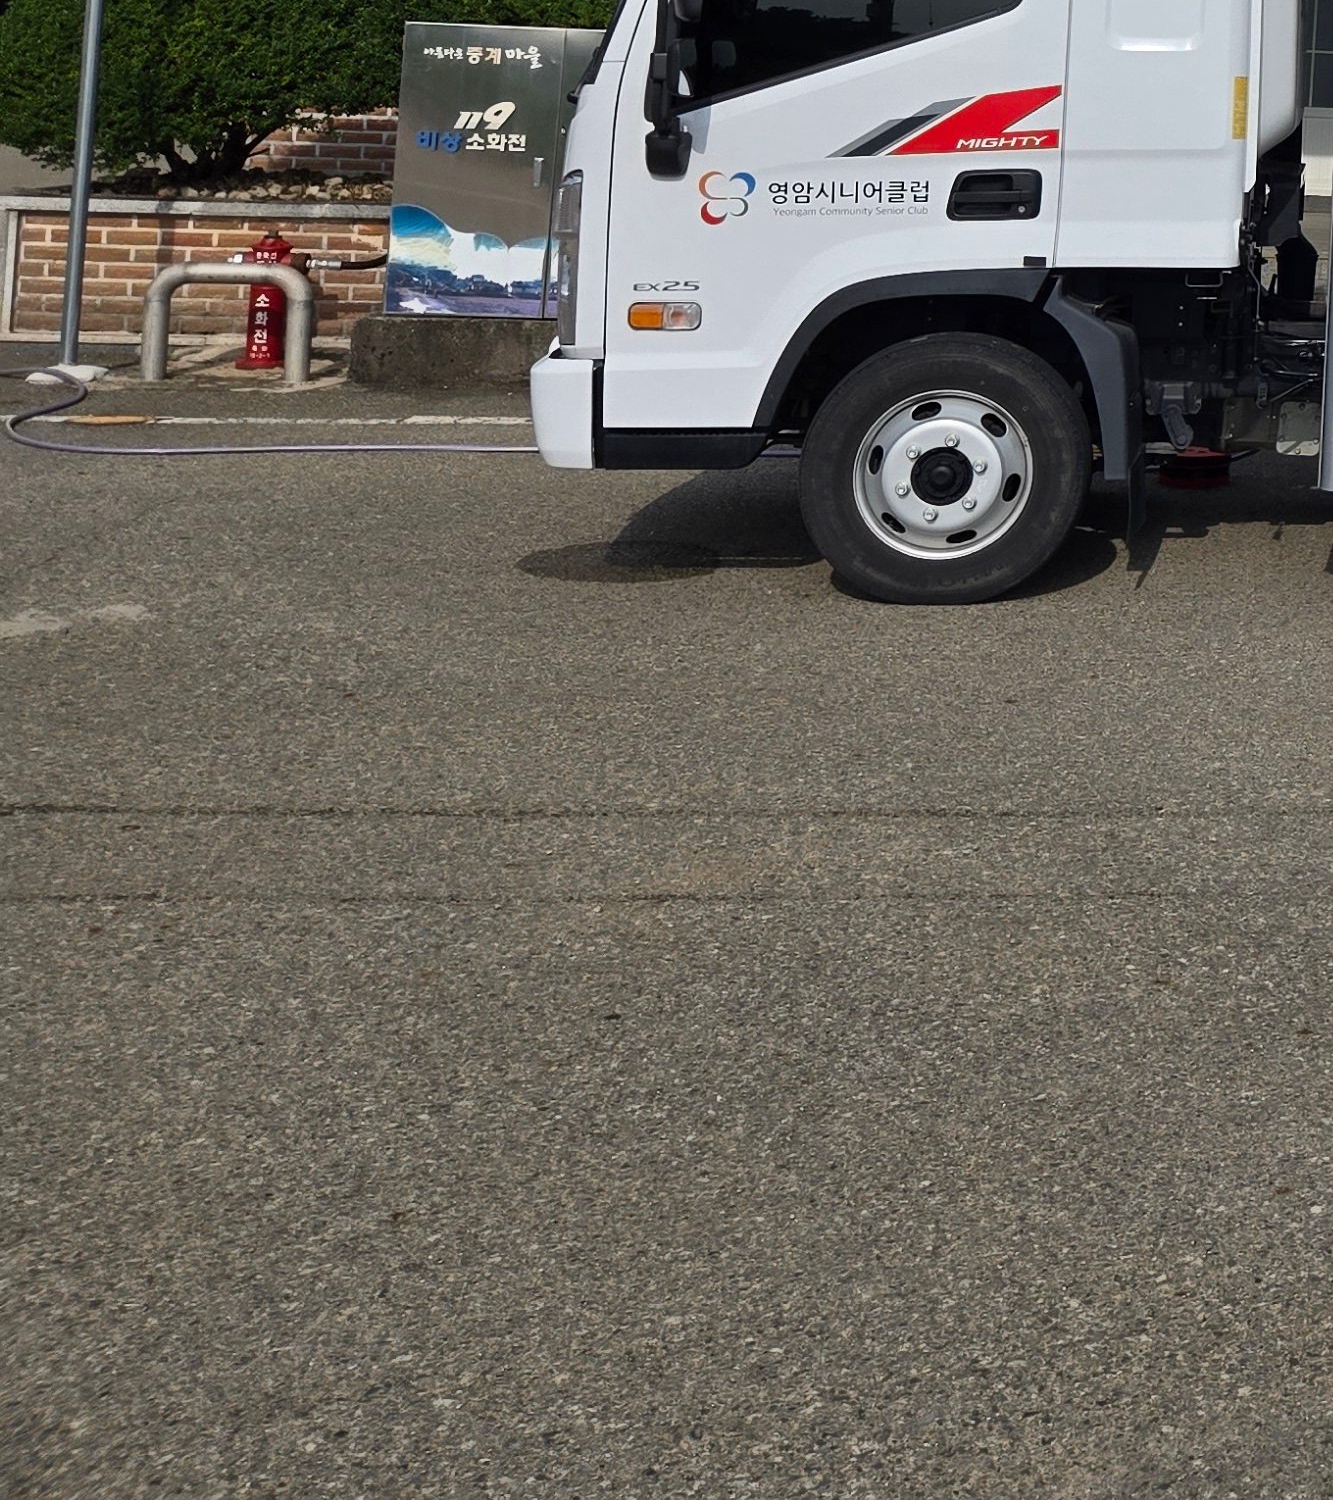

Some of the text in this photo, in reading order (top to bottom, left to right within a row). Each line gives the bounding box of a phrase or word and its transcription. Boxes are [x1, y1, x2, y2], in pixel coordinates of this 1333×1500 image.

[505, 45, 543, 70] 마을
[453, 101, 516, 130] 119
[416, 130, 526, 154] 비상 소화전
[956, 135, 1049, 149] MIGHTY
[768, 180, 930, 204] 영암시니어클럽
[773, 206, 928, 218] Yeongam Community Senior Club
[254, 294, 270, 344] 소화전
